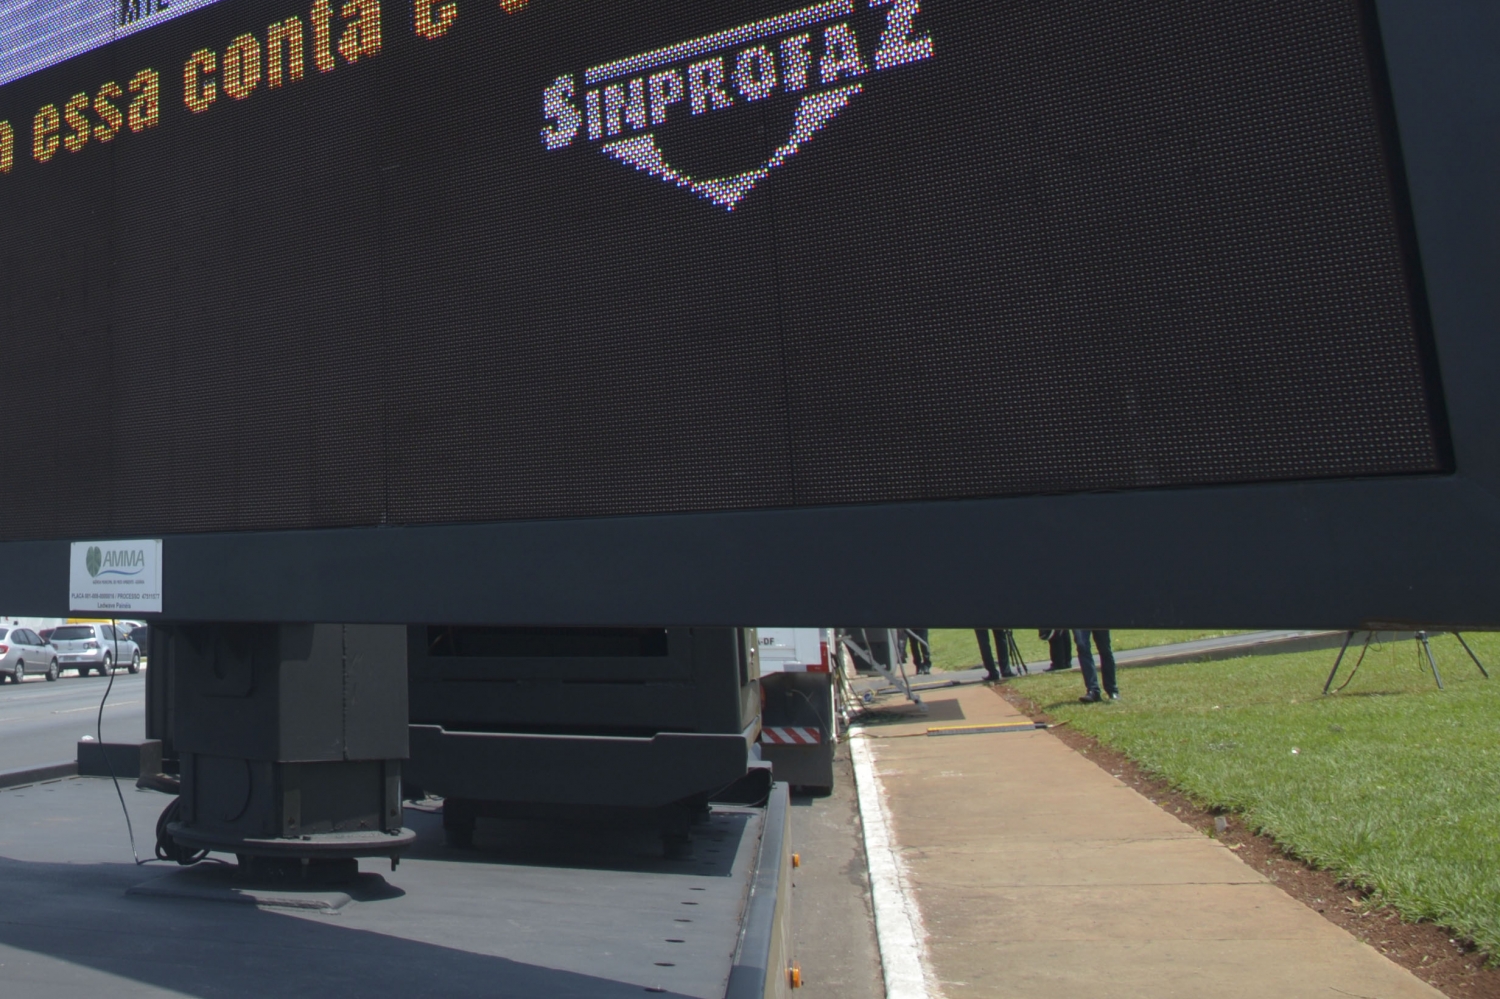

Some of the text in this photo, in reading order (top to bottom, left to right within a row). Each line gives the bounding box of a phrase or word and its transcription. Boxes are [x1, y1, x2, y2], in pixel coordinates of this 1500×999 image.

[32, 67, 160, 163] essa
[102, 549, 146, 568] AMMA
[117, 592, 140, 600] PROCESSO
